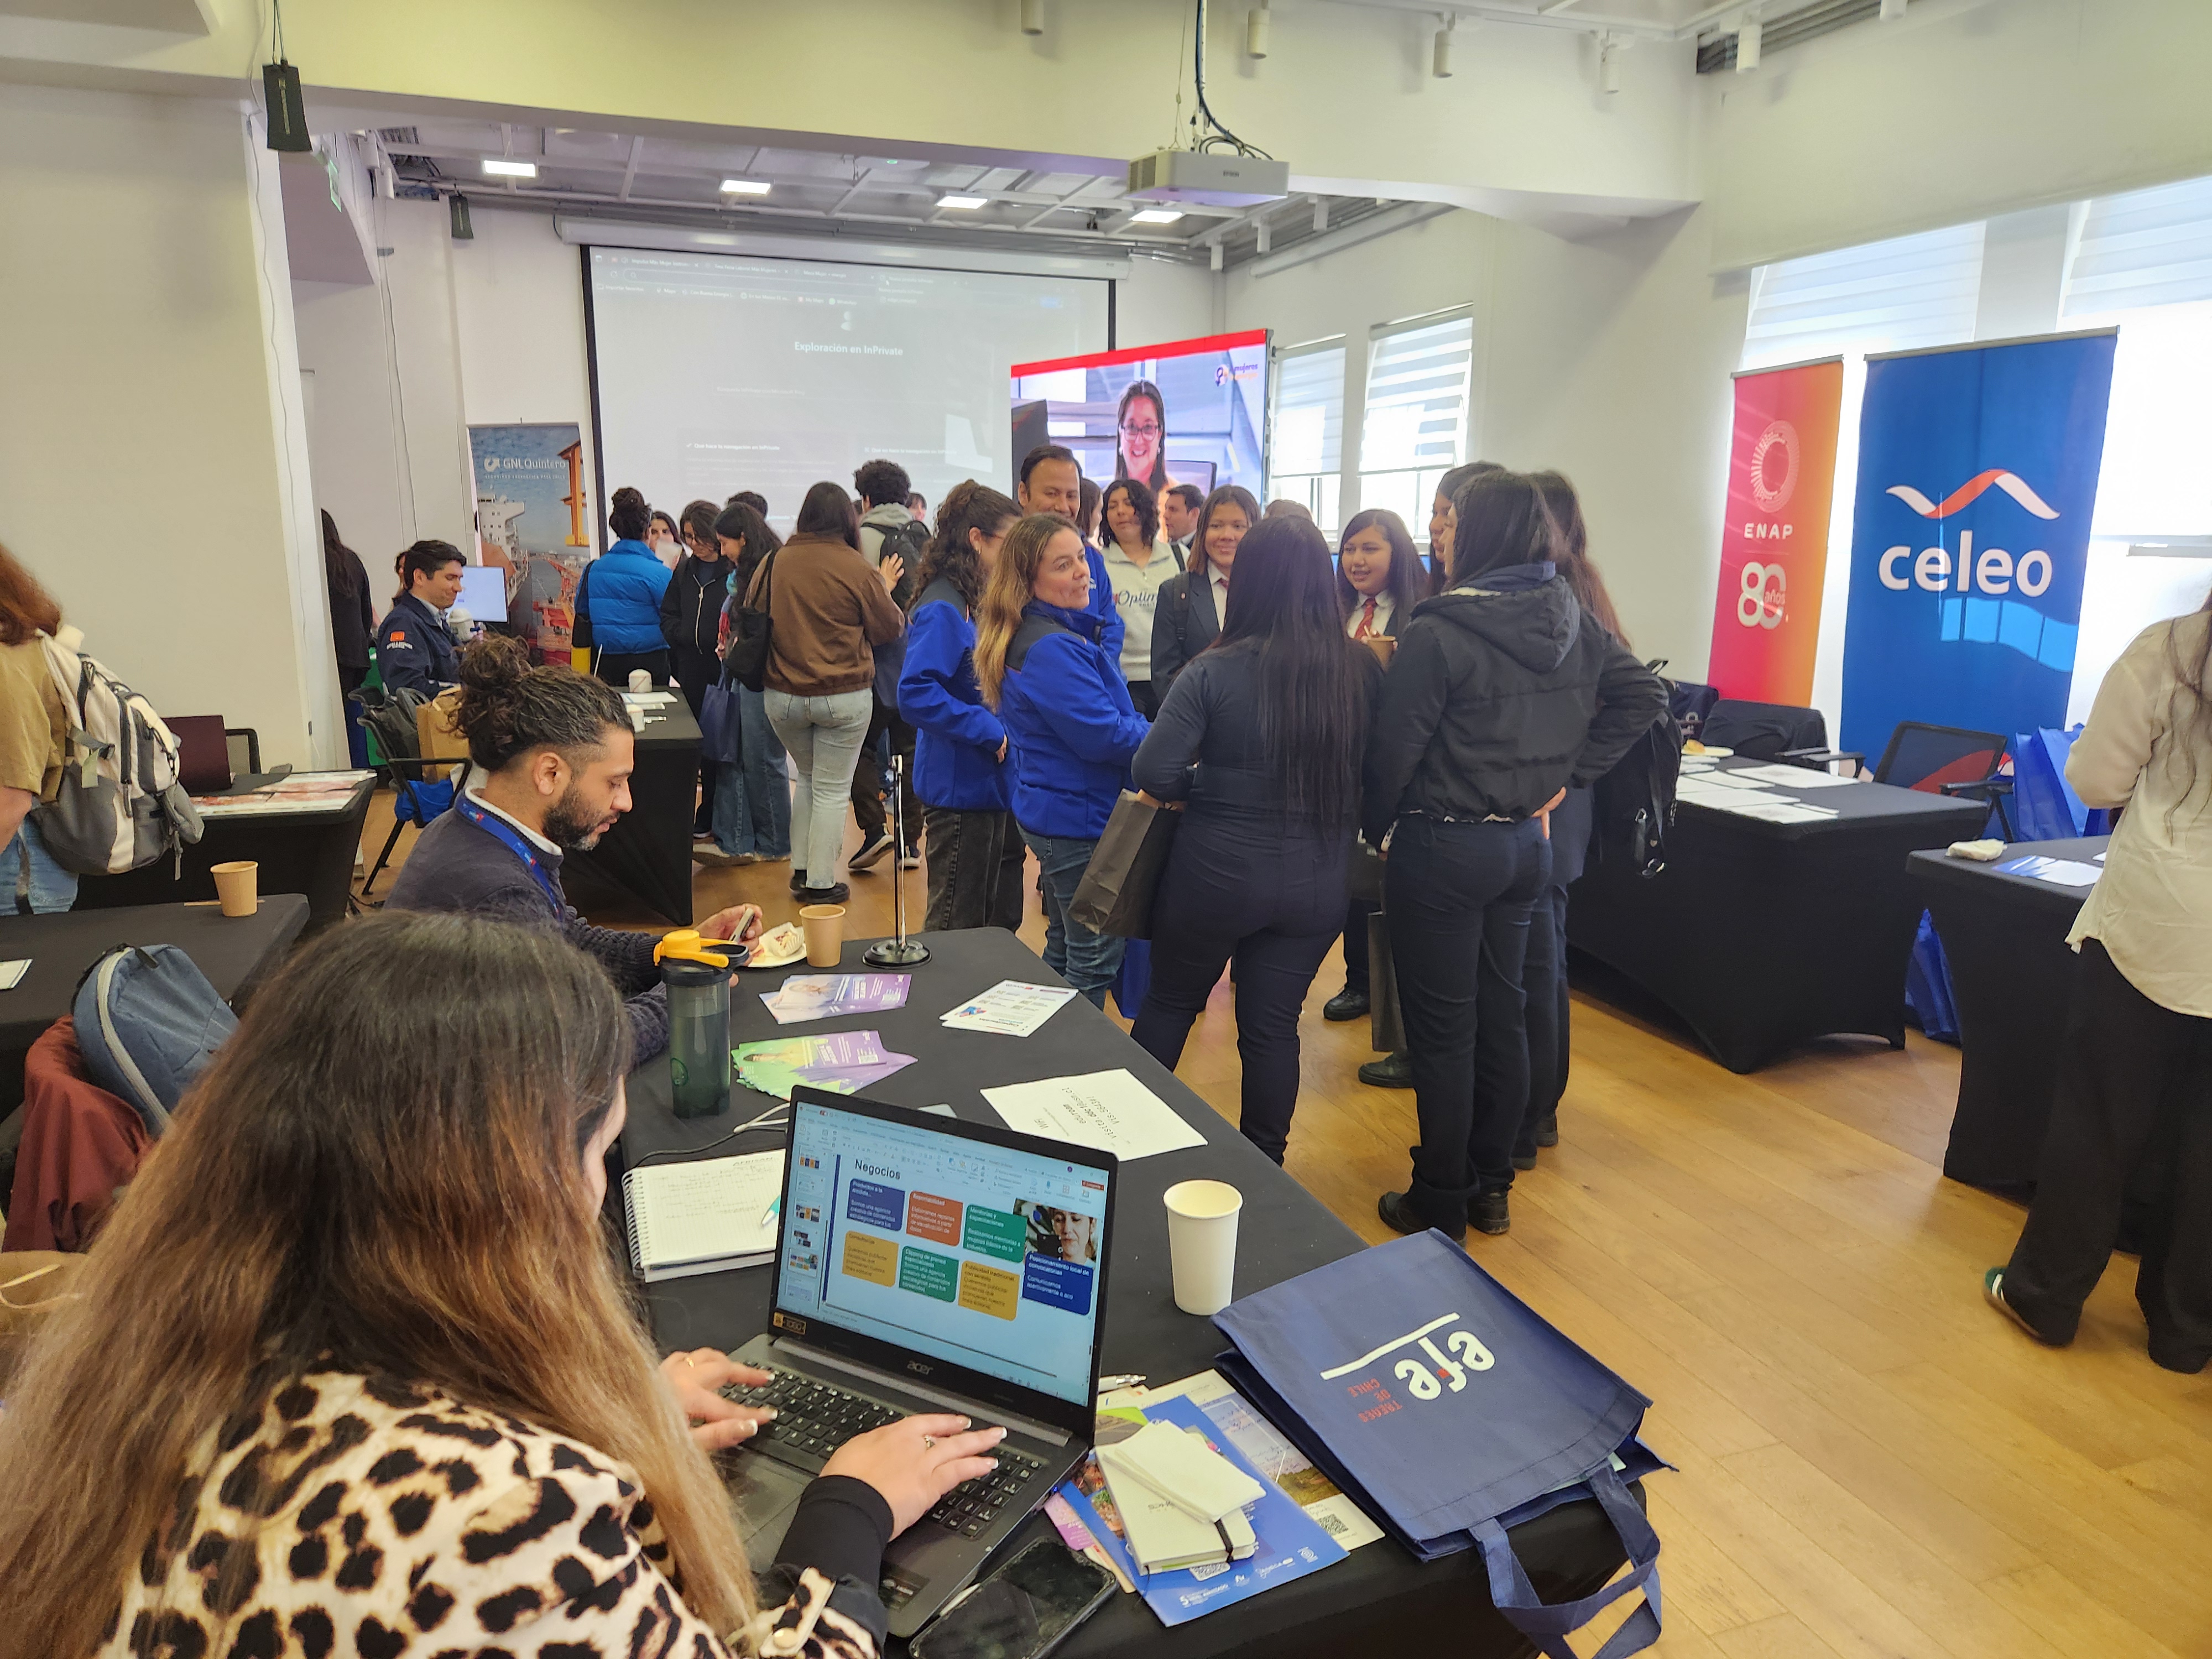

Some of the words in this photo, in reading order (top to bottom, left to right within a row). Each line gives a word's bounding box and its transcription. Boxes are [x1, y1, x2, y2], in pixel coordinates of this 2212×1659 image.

[794, 341, 848, 354] Exploración
[864, 345, 903, 356] InPrivate
[503, 457, 523, 469] GNL
[524, 457, 565, 469] Quintero
[1744, 523, 1793, 540] ENAP
[1879, 530, 2053, 598] celeo
[855, 1159, 901, 1180] Negocios
[1029, 1254, 1069, 1270] Posicionamiento
[1070, 1265, 1082, 1274] local
[907, 1360, 934, 1375] acer
[1348, 1378, 1380, 1398] CHILE
[1375, 1390, 1391, 1402] DE
